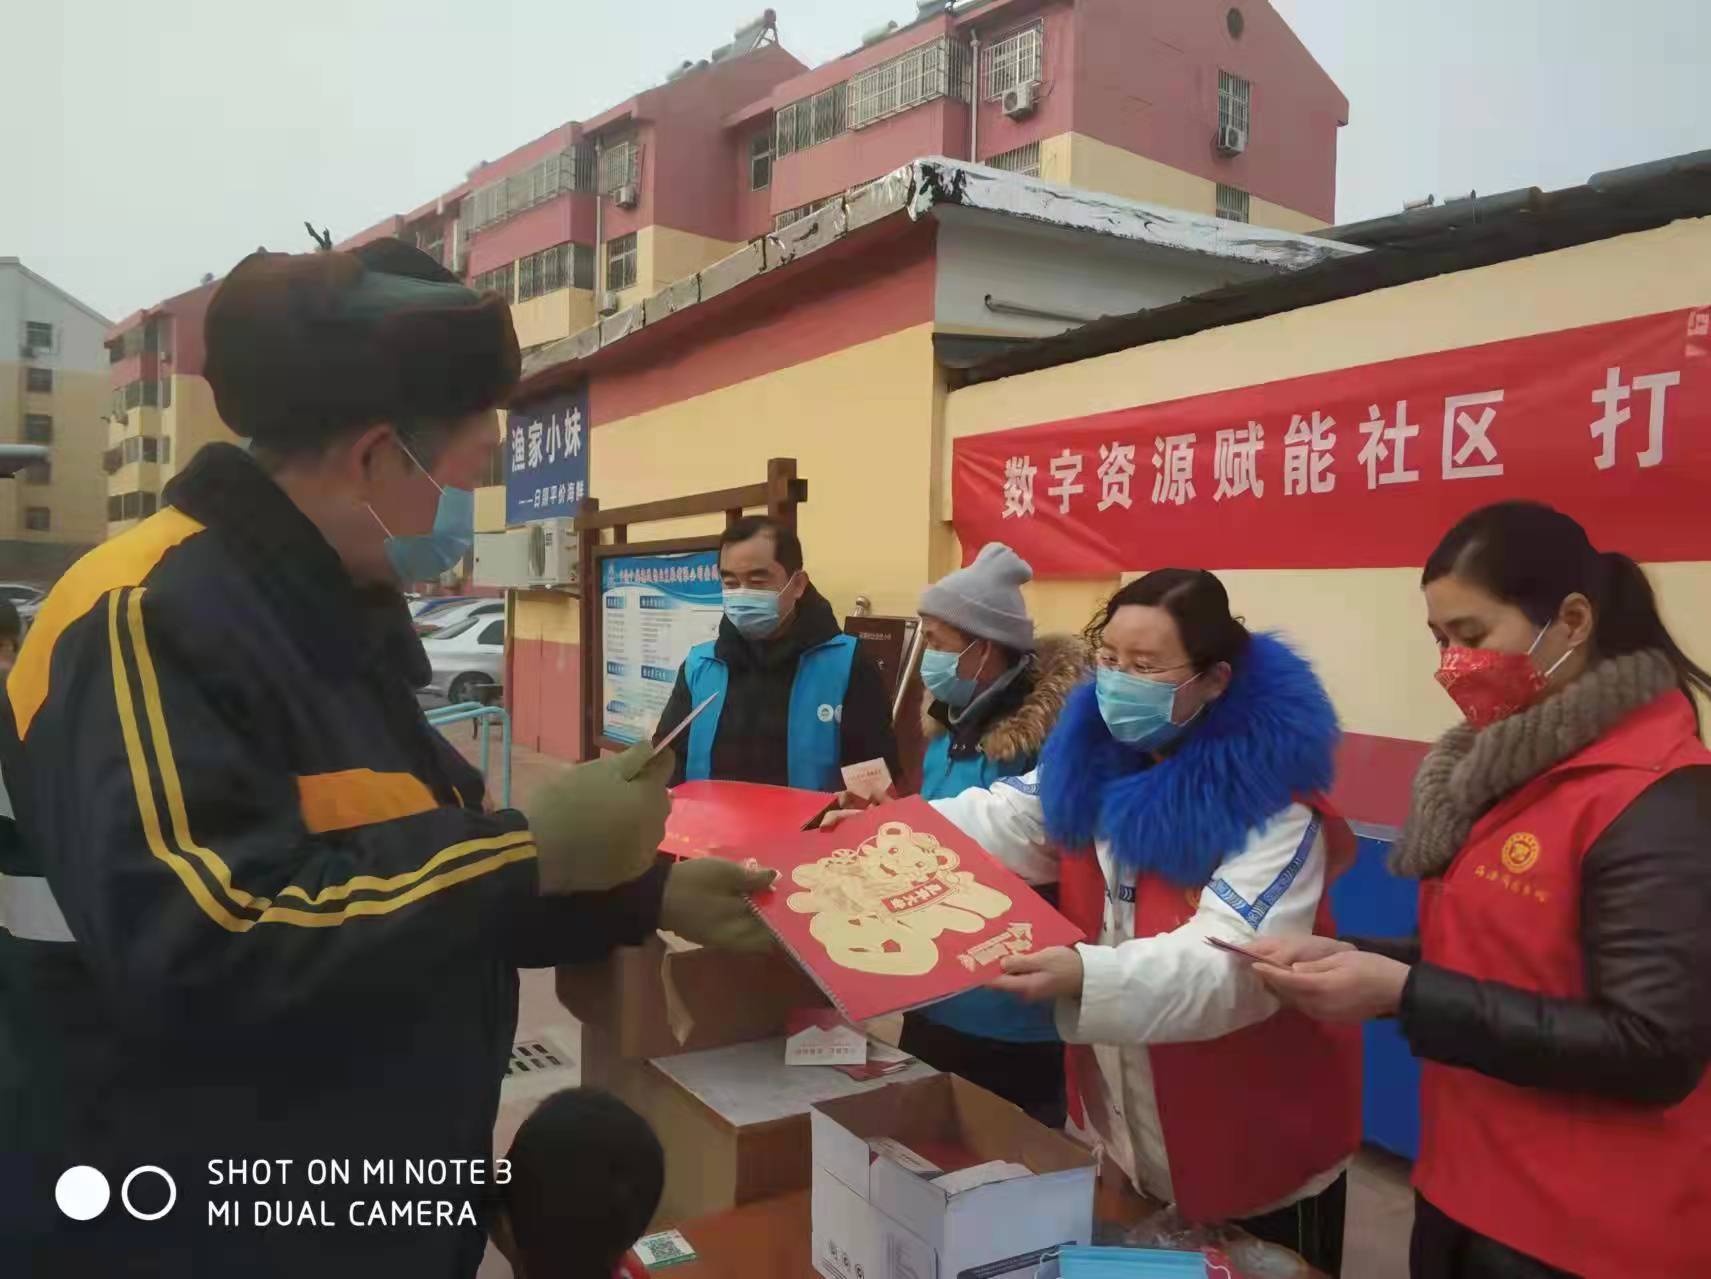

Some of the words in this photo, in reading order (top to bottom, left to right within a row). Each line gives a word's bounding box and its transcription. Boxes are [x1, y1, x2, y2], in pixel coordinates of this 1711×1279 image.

[511, 406, 582, 472] 渔家小妹
[1002, 389, 1504, 518] 数字资源赋能社区
[1591, 367, 1681, 470] 打
